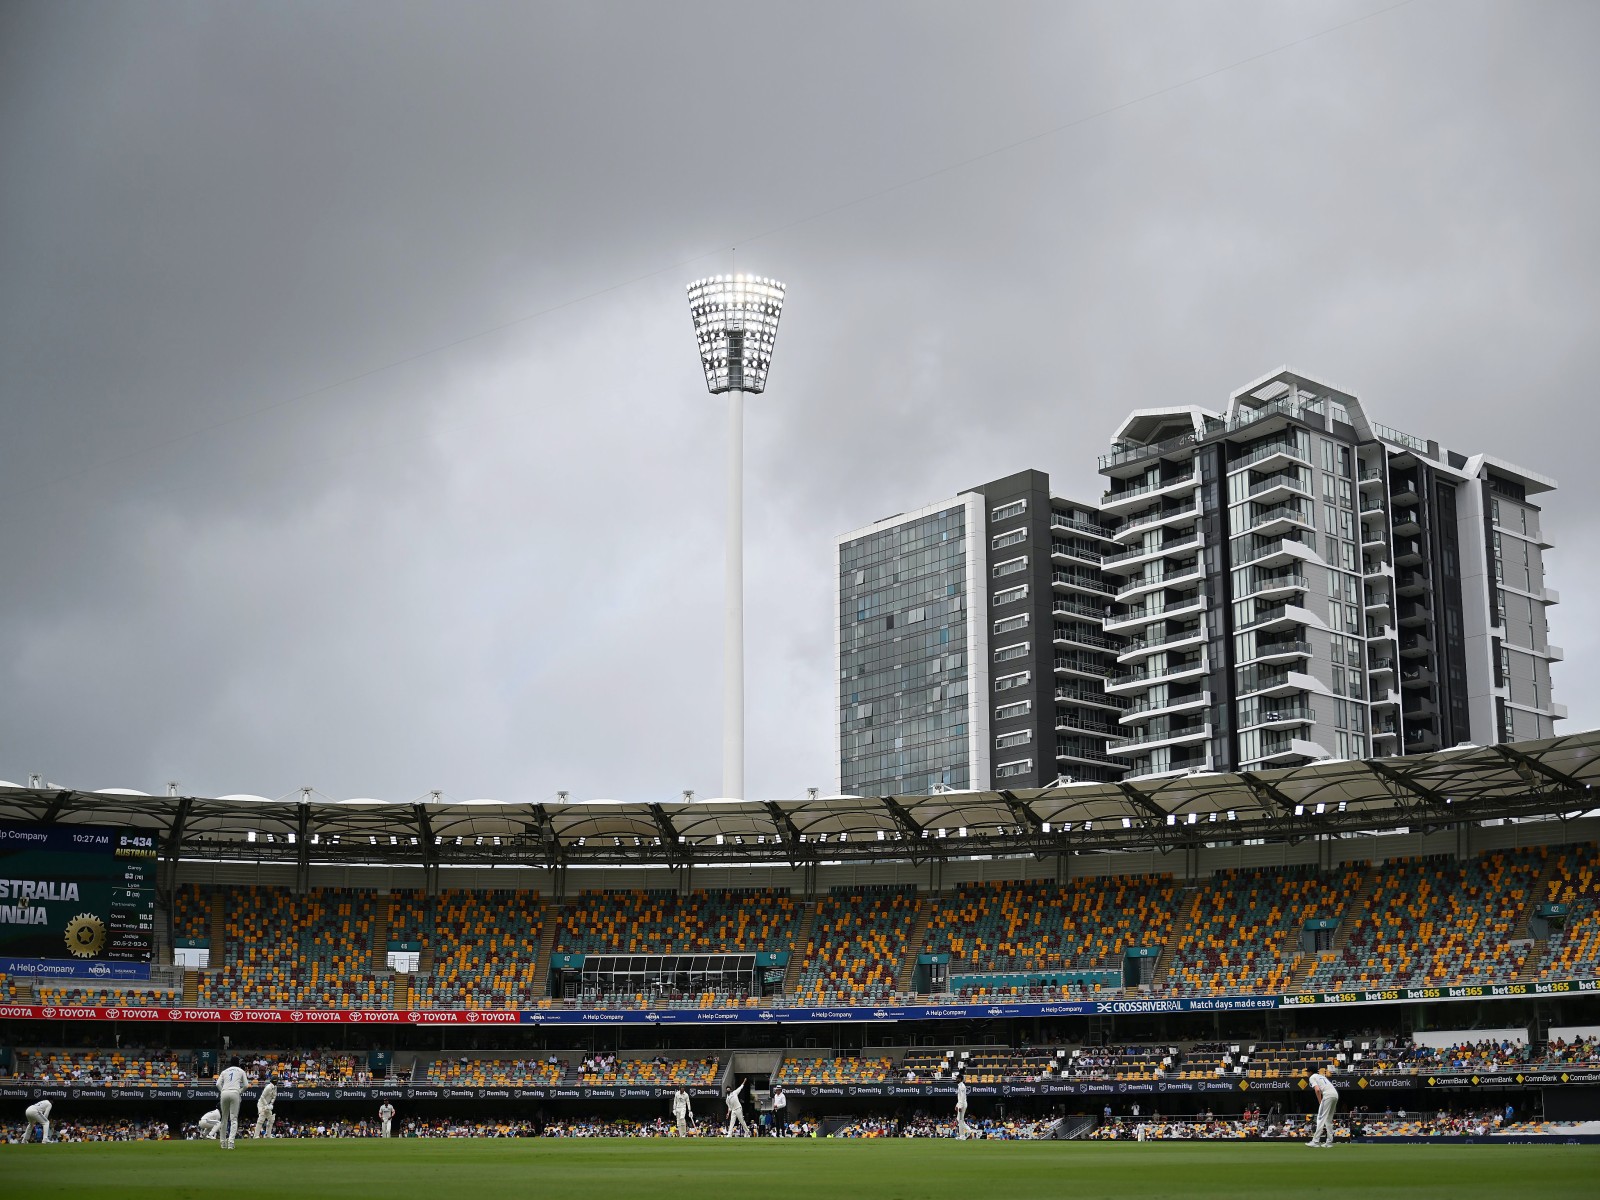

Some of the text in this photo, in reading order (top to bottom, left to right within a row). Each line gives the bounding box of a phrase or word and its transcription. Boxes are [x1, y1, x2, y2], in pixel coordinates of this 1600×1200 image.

[8, 830, 48, 842] Company
[73, 834, 95, 843] 10:27
[120, 836, 152, 847] 8-434
[115, 848, 156, 857] AUSTRALIA
[0, 905, 48, 925] NDIA
[17, 964, 36, 972] Help
[37, 964, 75, 974] Company
[1449, 987, 1482, 996] bet365
[1492, 985, 1526, 994] bet365
[1535, 982, 1570, 992] bet365
[1324, 993, 1356, 1003] bet365
[1365, 991, 1398, 1000] bet365
[1407, 989, 1440, 998] bet365
[1284, 995, 1315, 1004] bet365
[1113, 1001, 1183, 1012] CROSSRIVERRAIL
[1191, 999, 1275, 1010] Match days made easy
[0, 1007, 32, 1016] OYOTA
[59, 1009, 96, 1017] TOYOTA
[122, 1010, 158, 1018] TOYOTA
[185, 1011, 220, 1019] TOYOTA
[246, 1012, 281, 1020] TOYOTA
